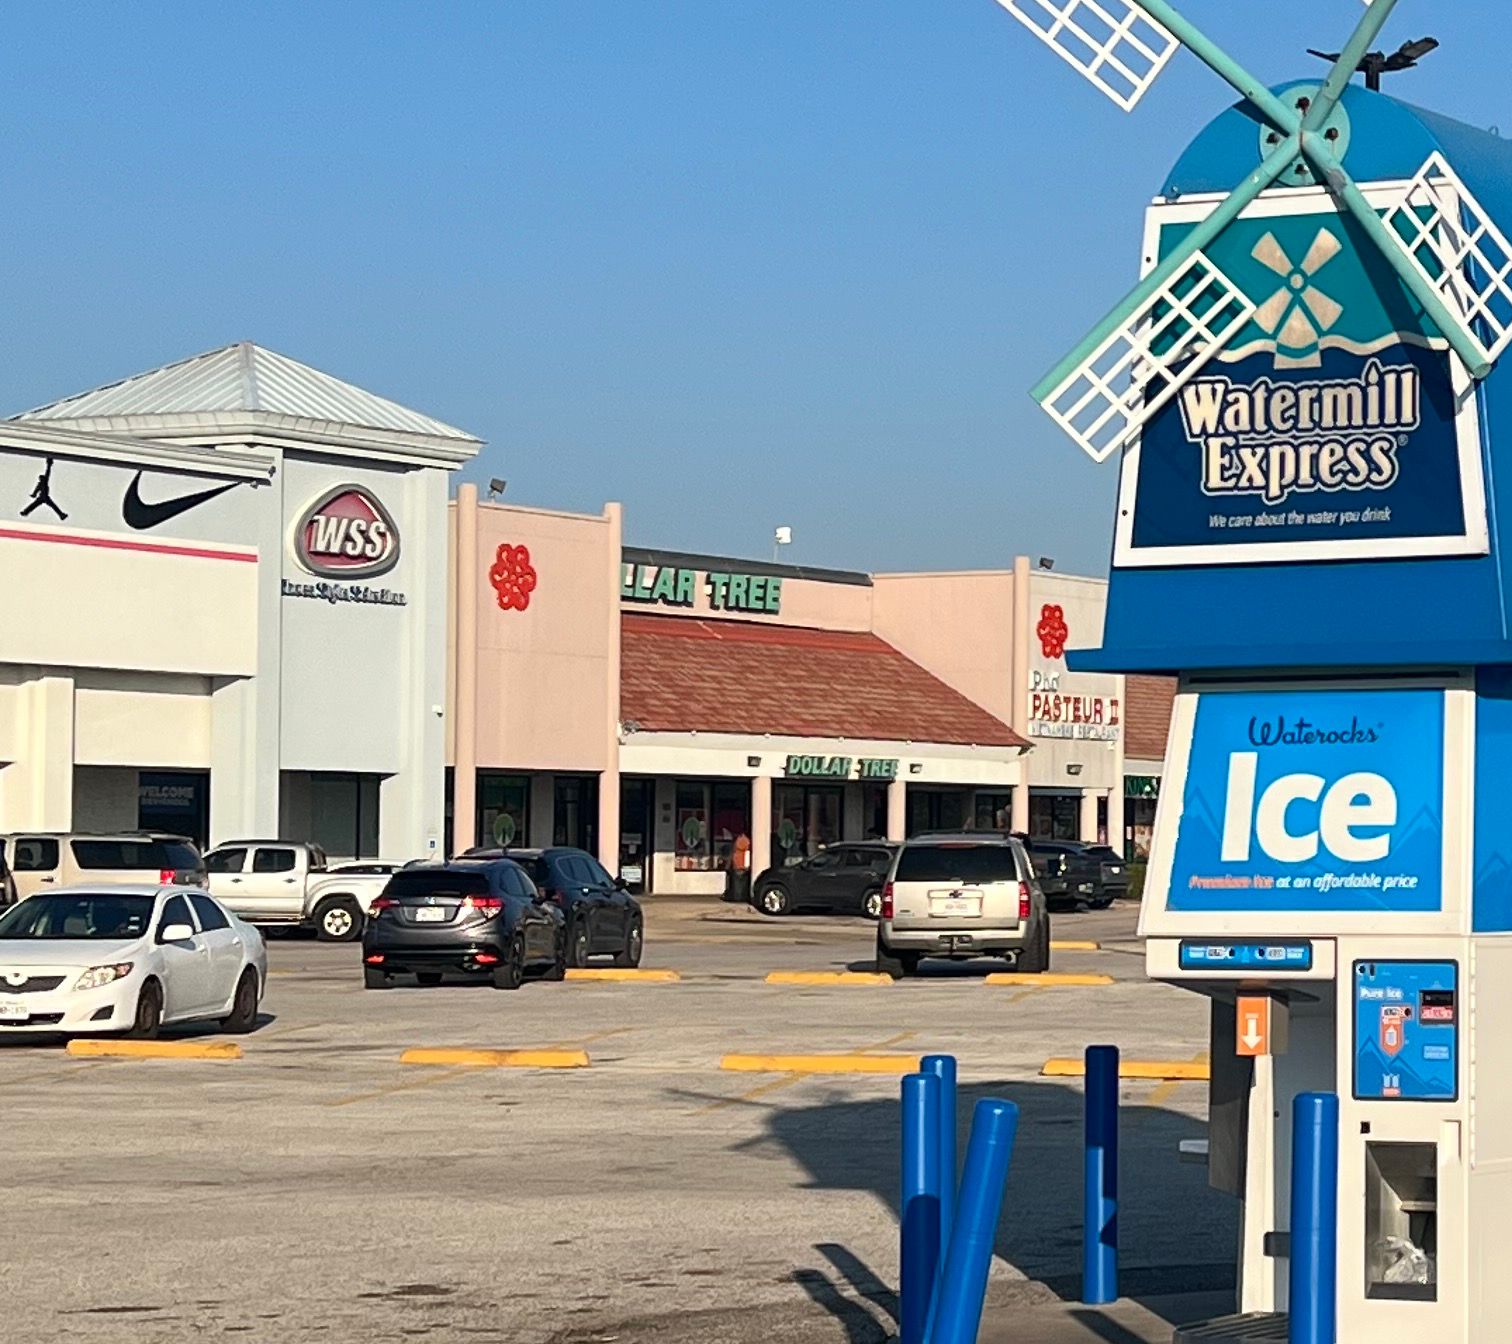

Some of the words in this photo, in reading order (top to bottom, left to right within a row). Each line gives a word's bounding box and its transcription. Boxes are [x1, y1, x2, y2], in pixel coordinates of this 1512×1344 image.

[1182, 360, 1416, 436] Watermill
[1205, 437, 1394, 499] Express
[1209, 514, 1226, 528] We
[1228, 515, 1252, 527] care
[1254, 511, 1285, 527] about
[1287, 509, 1304, 525] the
[1307, 511, 1338, 524] water
[1339, 510, 1360, 526] you
[1361, 505, 1392, 522] drink
[307, 515, 387, 558] WSS
[707, 572, 783, 612] TREE
[1029, 694, 1103, 725] PASTEUR
[1248, 715, 1380, 747] Waterocks
[786, 756, 852, 776] DOLLAR
[860, 758, 898, 777] TREE
[1220, 750, 1398, 864] Ice
[1275, 875, 1291, 889] at
[1293, 876, 1311, 889] an
[1313, 873, 1382, 893] affordable
[1383, 874, 1419, 892] price
